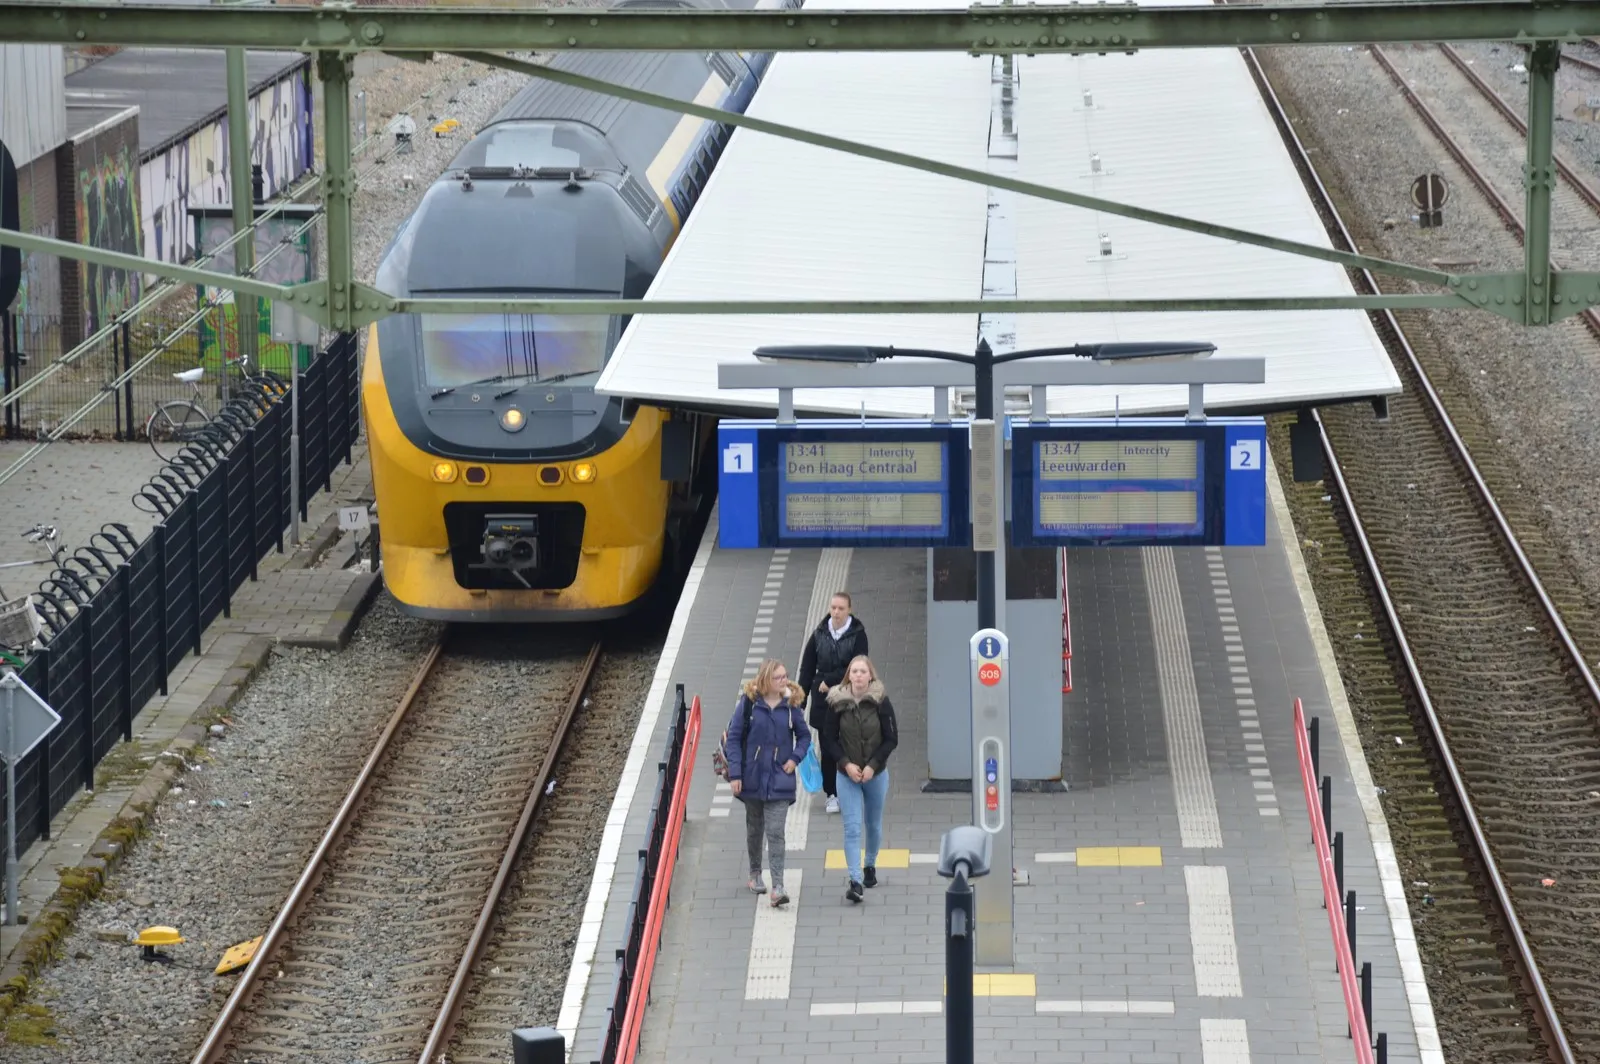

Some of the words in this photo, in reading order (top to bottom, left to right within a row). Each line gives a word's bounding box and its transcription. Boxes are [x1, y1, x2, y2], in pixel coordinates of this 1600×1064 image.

[790, 444, 825, 457] 13:41
[869, 448, 915, 460] Intercity
[1043, 443, 1080, 455] 13:47
[1124, 445, 1170, 457] Intercity
[733, 454, 742, 470] 1
[1042, 460, 1126, 472] Leeuwarden
[1240, 450, 1251, 467] 2
[788, 462, 814, 474] Den
[820, 462, 854, 477] Haag
[859, 461, 917, 474] Centraal
[349, 512, 359, 523] 17
[981, 669, 1000, 679] SOS
